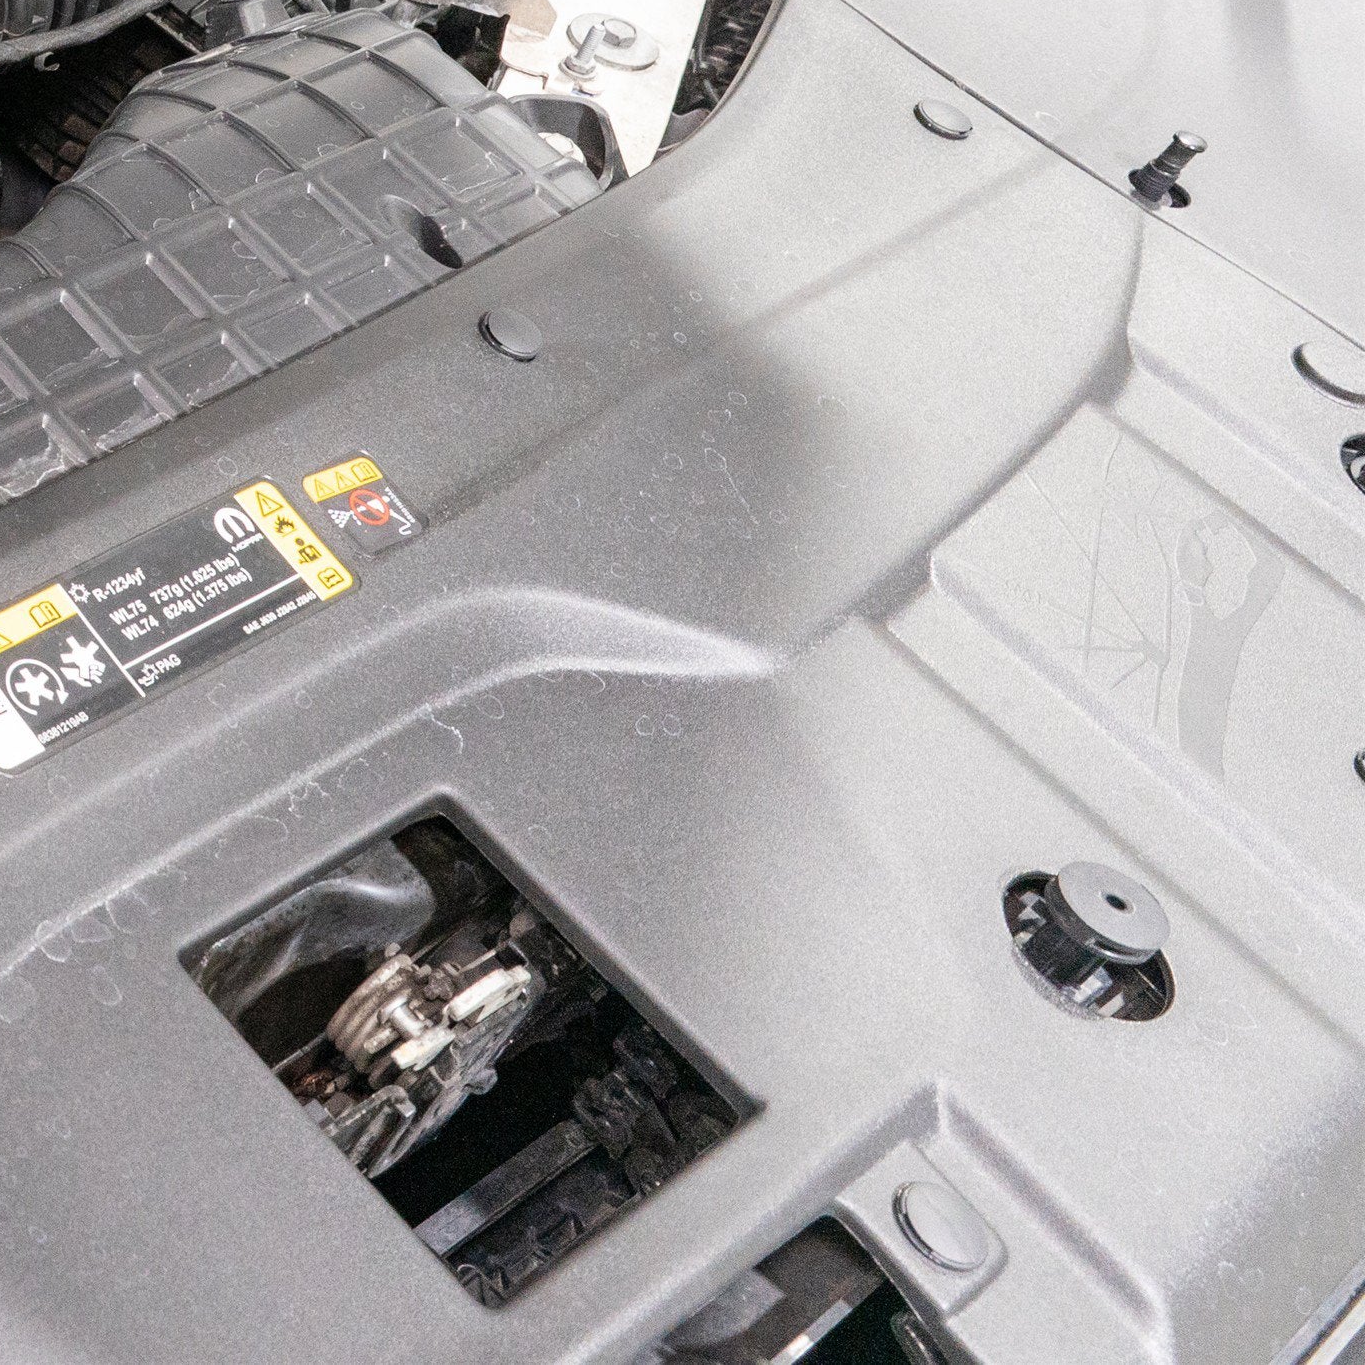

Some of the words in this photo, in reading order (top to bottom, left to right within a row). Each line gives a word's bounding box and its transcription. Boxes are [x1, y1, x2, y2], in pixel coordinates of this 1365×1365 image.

[231, 532, 264, 553] MOPAR
[91, 566, 147, 602] R-1234yf
[109, 599, 148, 626] WL75
[149, 583, 185, 605] 737g
[178, 564, 217, 593] (1.625
[216, 552, 240, 573] lbs)
[121, 615, 160, 641] WL74
[162, 598, 197, 620] 624g
[191, 579, 230, 608] (1.375
[228, 567, 253, 588] lbs)
[242, 621, 261, 635] SAE
[154, 653, 182, 675] PAG
